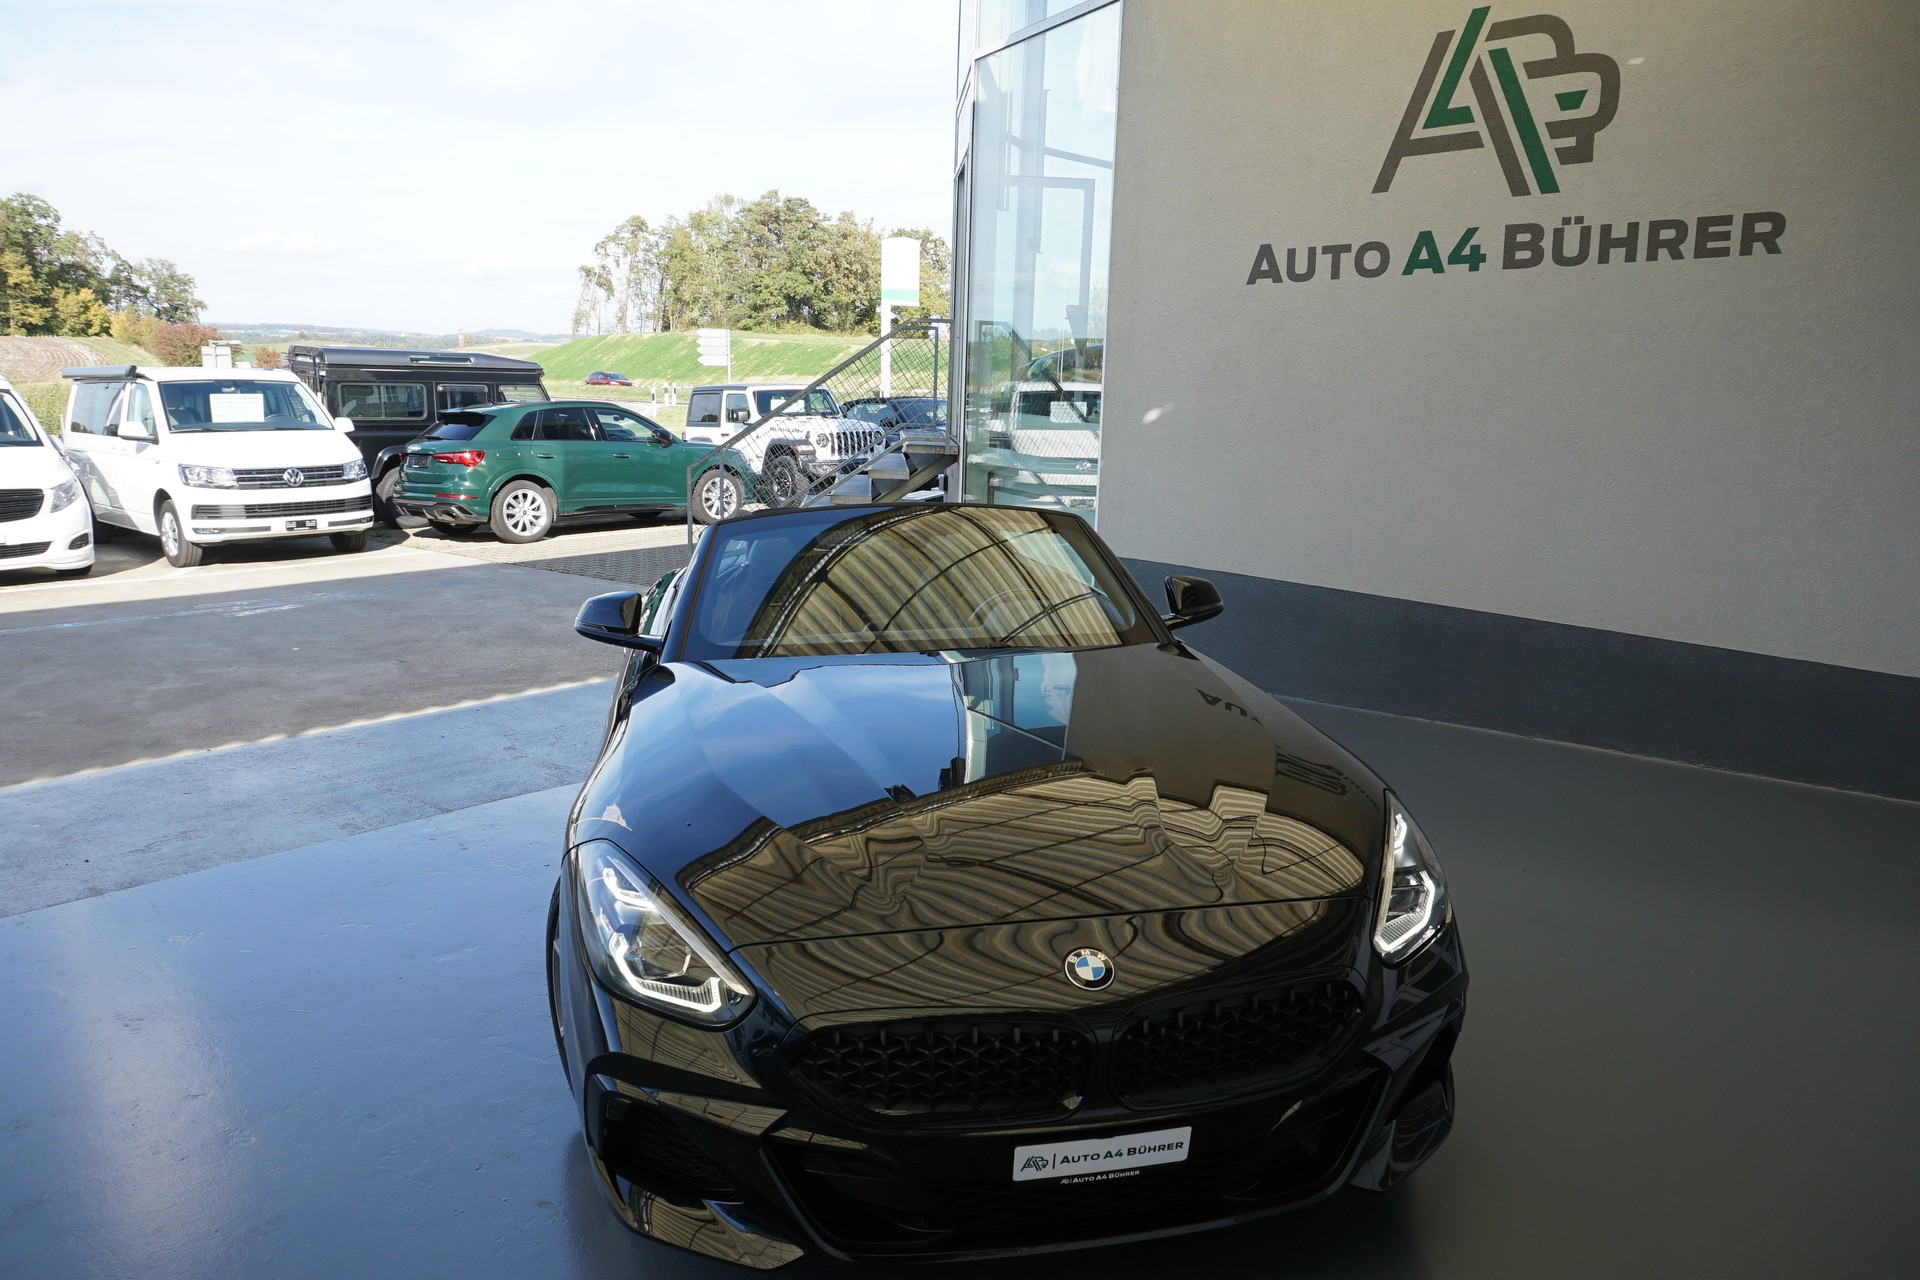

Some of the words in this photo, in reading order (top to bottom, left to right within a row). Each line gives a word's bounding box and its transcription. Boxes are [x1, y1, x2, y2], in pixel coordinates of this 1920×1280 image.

[1245, 240, 1391, 286] AUTO
[1401, 226, 1487, 277] A4
[1501, 210, 1787, 271] BÜHRER
[1068, 949, 1107, 963] BMW
[1060, 1153, 1101, 1165] AUTO
[1103, 1149, 1124, 1160] A4
[1126, 1141, 1184, 1156] BÜHRER
[1072, 1176, 1095, 1184] AUTO
[1096, 1173, 1107, 1181] A4
[1108, 1170, 1140, 1179] BÜHRER
